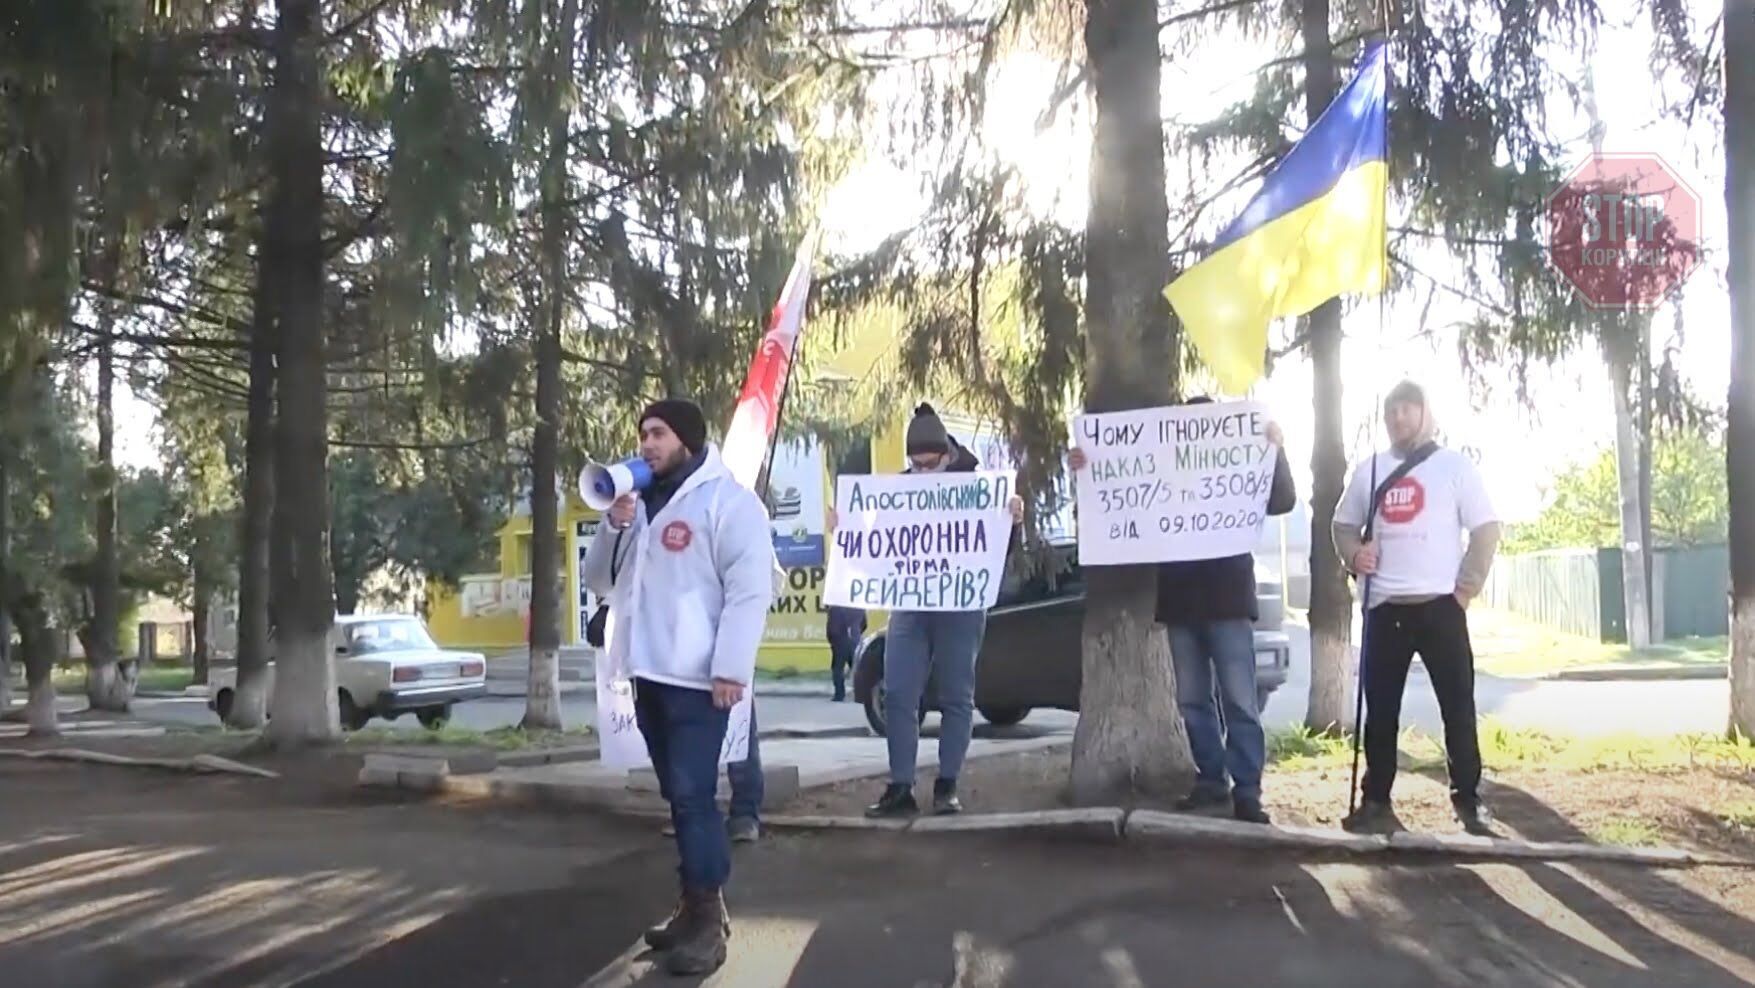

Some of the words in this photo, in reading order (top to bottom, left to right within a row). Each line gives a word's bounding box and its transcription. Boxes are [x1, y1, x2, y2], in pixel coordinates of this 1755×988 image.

[1159, 412, 1264, 443] ІГНОРУЄТЕ
[1091, 453, 1156, 483] НАКАЗ
[1098, 478, 1172, 513] 3507/5
[1200, 470, 1271, 501] 3508/5
[1385, 486, 1416, 506] STOP
[838, 530, 862, 558] ЧИ
[868, 519, 988, 558] ОХОРОННА
[895, 558, 949, 575] ФІРМА
[850, 566, 990, 608] РЕЙДЕРІВ?
